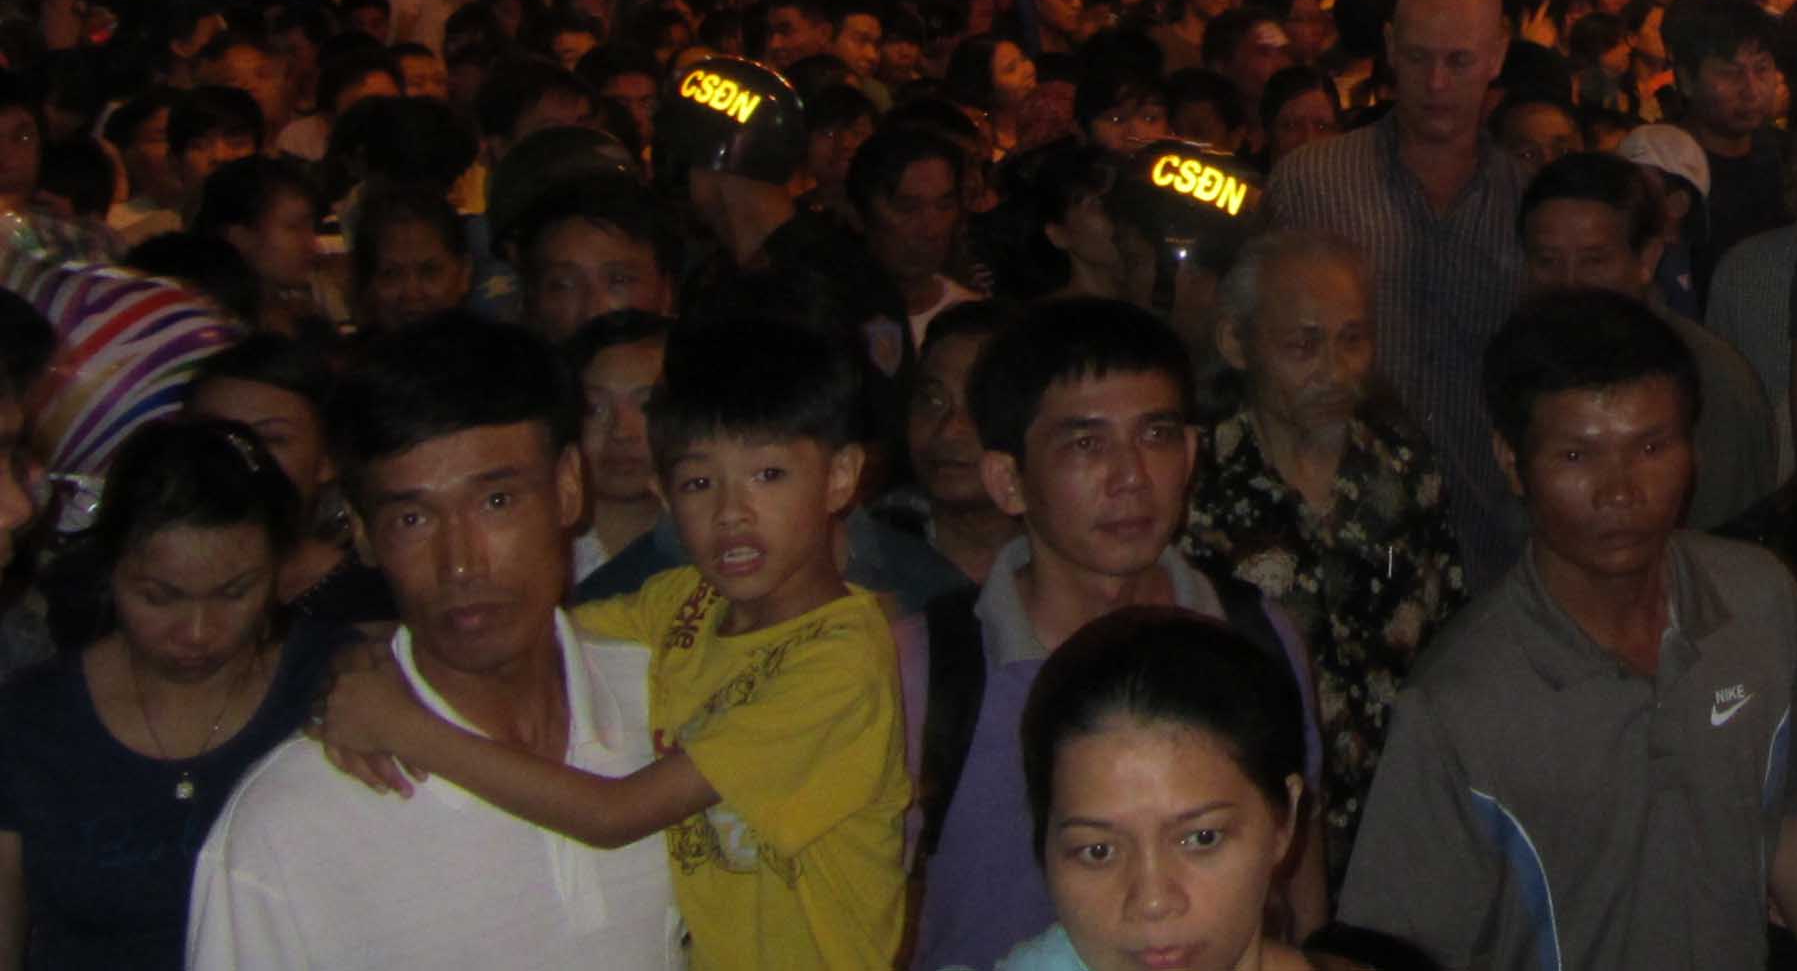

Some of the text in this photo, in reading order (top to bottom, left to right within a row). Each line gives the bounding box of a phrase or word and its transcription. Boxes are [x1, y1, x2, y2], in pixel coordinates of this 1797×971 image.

[680, 69, 762, 124] CSĐN
[1151, 154, 1248, 216] CSĐN
[1715, 684, 1745, 704] NIKE
